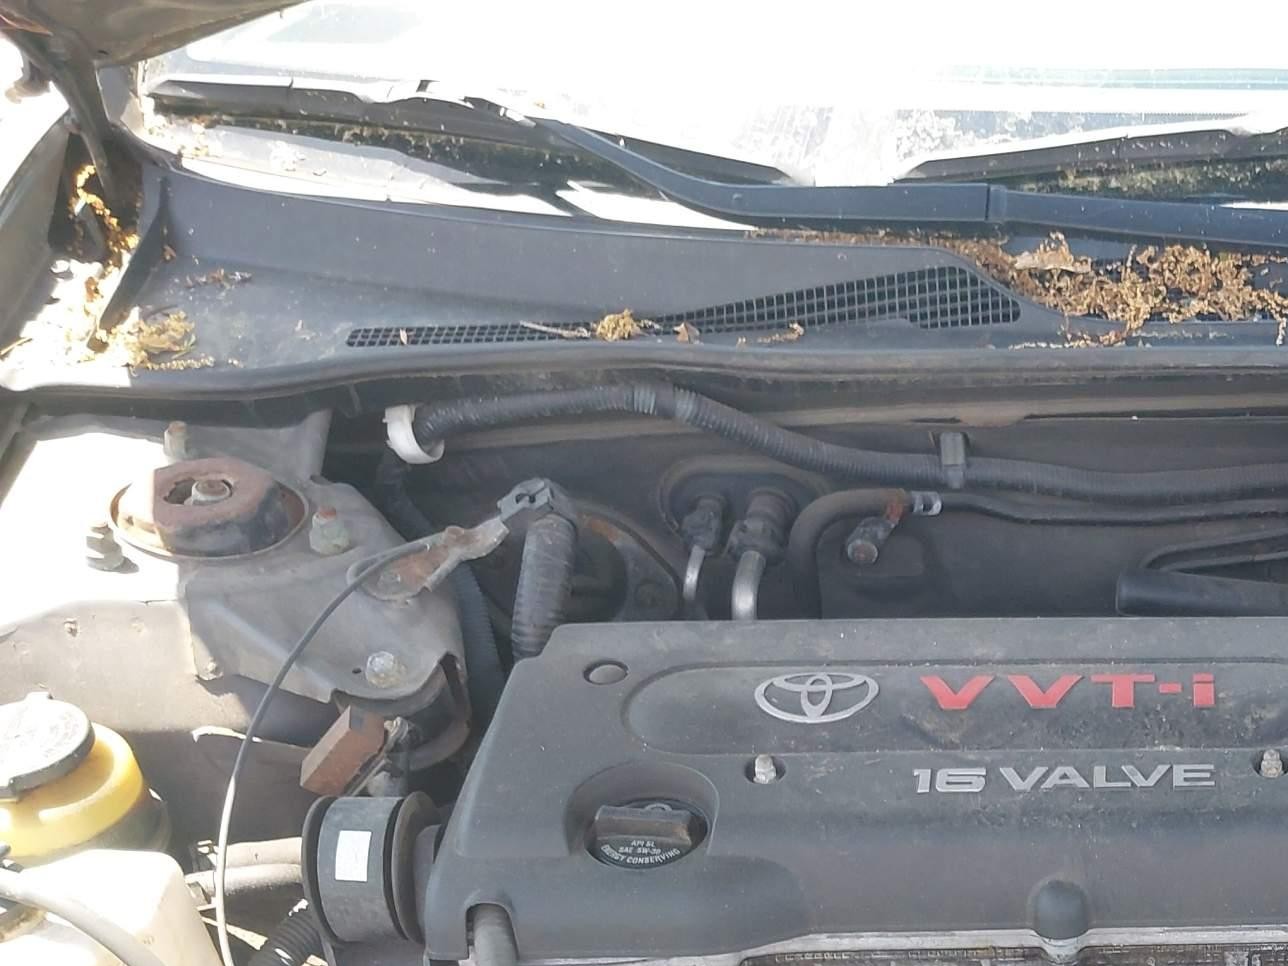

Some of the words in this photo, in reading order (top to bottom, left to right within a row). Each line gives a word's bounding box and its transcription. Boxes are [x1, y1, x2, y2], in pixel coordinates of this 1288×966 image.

[919, 672, 1216, 710] VVT-i
[913, 766, 987, 793] 16
[999, 763, 1216, 792] VALVE
[631, 840, 645, 848] API
